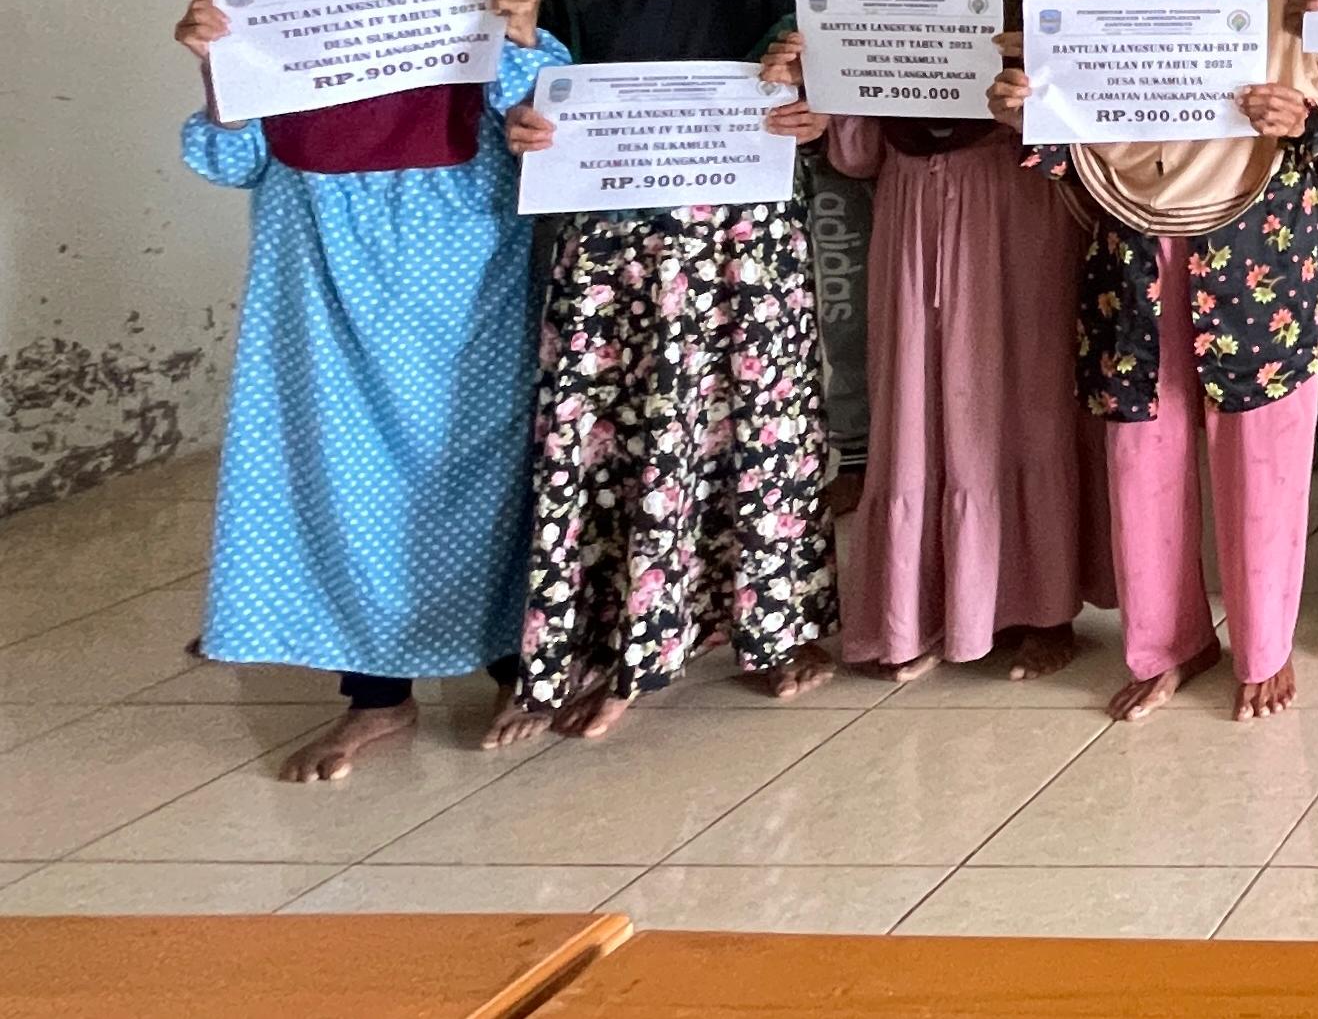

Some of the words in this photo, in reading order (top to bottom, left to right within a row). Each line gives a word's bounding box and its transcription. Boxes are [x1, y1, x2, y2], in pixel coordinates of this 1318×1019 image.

[1053, 44, 1108, 54] BANTUAN
[1112, 44, 1173, 53] LANGSUNG
[313, 50, 472, 89] RP.900.000
[1076, 61, 1137, 70] TRIWULAN
[1142, 61, 1154, 69] IV
[1157, 60, 1197, 69] TAHUN
[1107, 77, 1135, 85] DESA
[859, 86, 960, 100] RP.900.000
[1096, 110, 1215, 122] RP.900.000
[601, 173, 735, 190] RP.900.000
[814, 192, 862, 323] adidas
